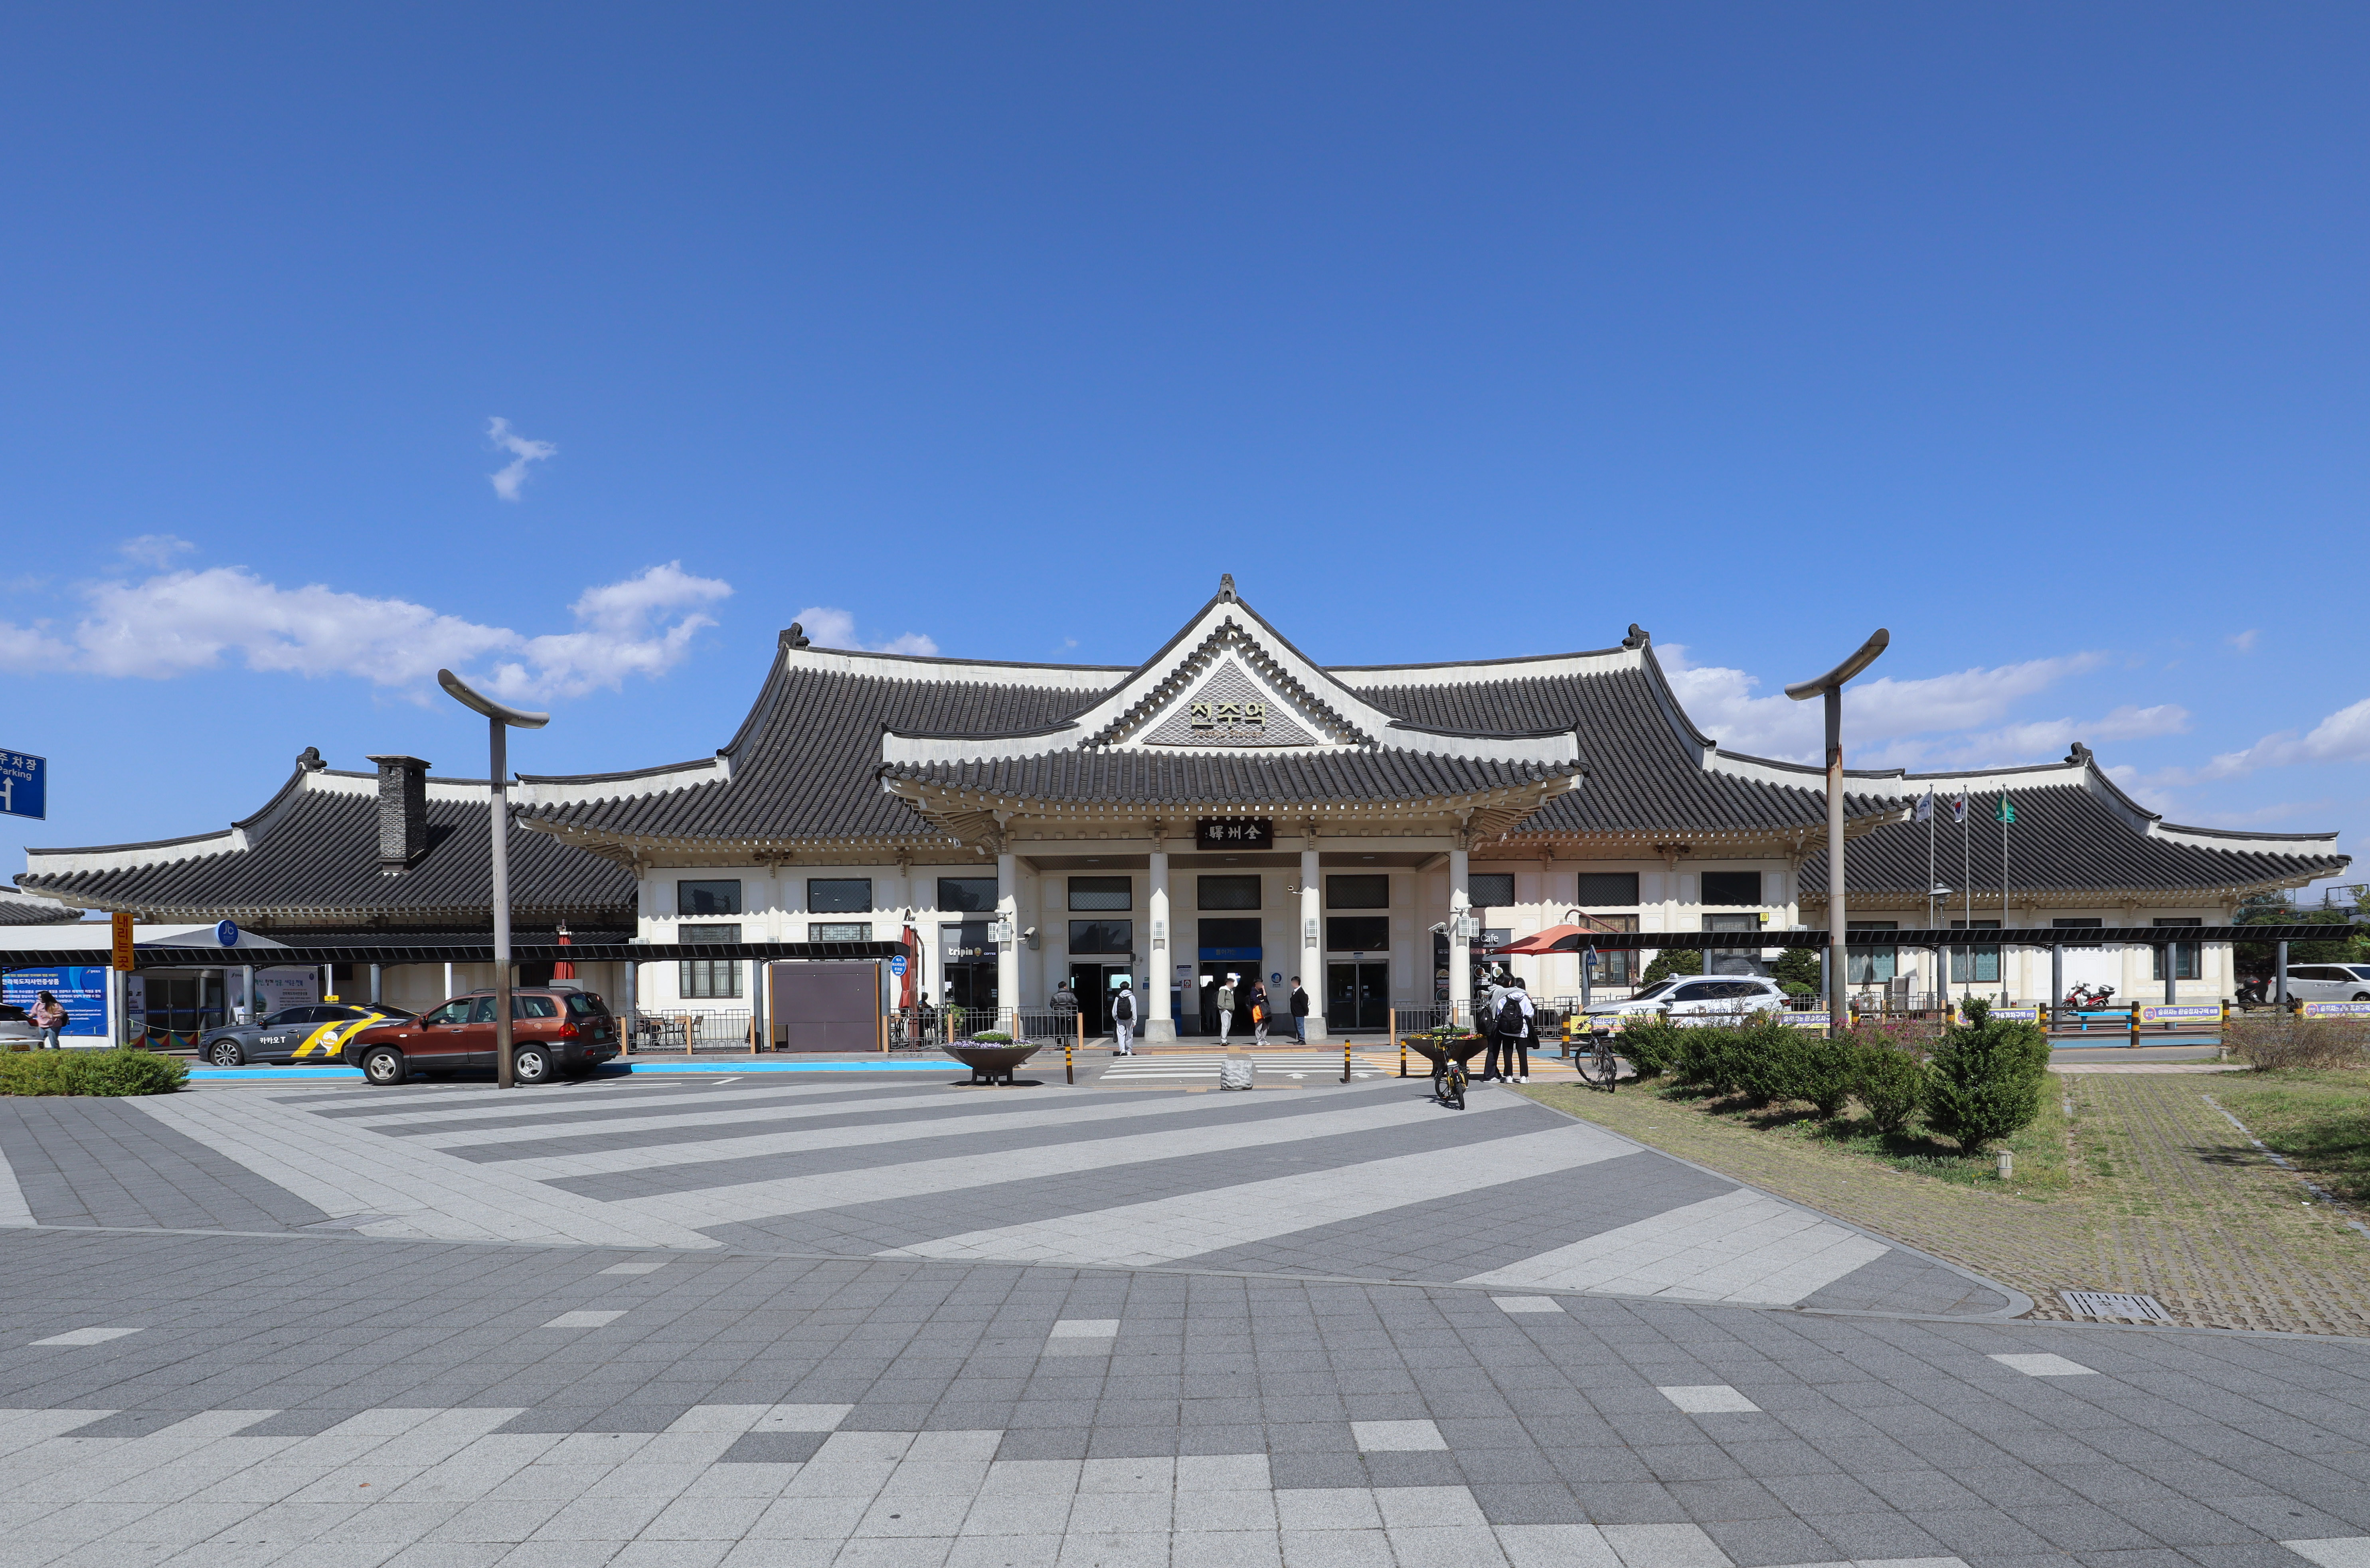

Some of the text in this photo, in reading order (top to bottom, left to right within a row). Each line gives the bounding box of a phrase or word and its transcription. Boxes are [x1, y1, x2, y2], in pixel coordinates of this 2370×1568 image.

[1191, 702, 1266, 727] 전주역
[1194, 729, 1263, 739] Jeonju Station
[0, 752, 37, 770] 주차장
[117, 915, 128, 968] 내리는 곳
[1481, 933, 1499, 942] Cafe
[948, 946, 973, 958] tripin
